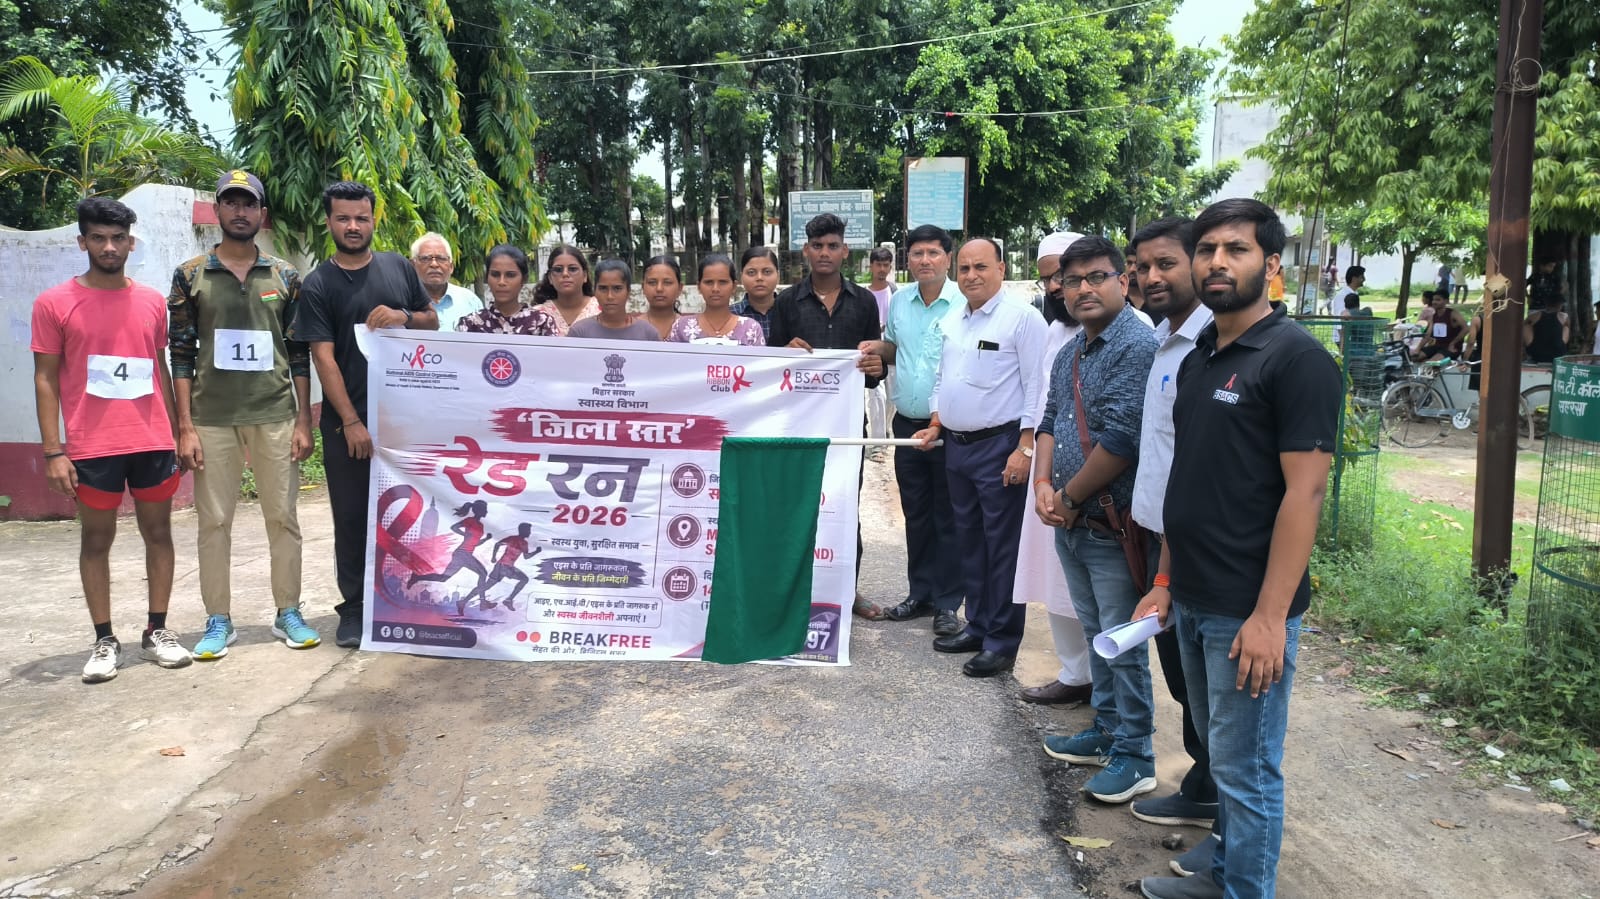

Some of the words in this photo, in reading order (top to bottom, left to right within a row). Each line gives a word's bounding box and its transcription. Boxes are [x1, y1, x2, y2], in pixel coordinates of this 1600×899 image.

[232, 343, 258, 361] 11
[113, 363, 128, 381] 4
[707, 365, 730, 378] RED
[795, 371, 840, 385] BSACS
[592, 387, 610, 396] बिहार
[612, 389, 635, 397] सरकार
[710, 384, 730, 392] Club
[578, 398, 614, 408] स्वास्थ्य
[617, 398, 648, 408] विभाग
[442, 436, 540, 497] रेड
[546, 454, 650, 502] रन
[552, 503, 628, 526] 2026
[552, 538, 571, 546] स्वस्थ
[591, 538, 617, 550] सुरक्षित
[618, 541, 640, 550] समाज
[570, 560, 578, 570] के
[580, 561, 593, 571] प्रति
[552, 571, 571, 582] जीवन
[573, 572, 580, 582] के
[582, 573, 595, 583] प्रति
[543, 609, 555, 618] और
[556, 611, 577, 619] स्वस्थ
[550, 631, 652, 648] BREAKFREE
[807, 630, 830, 650] 97
